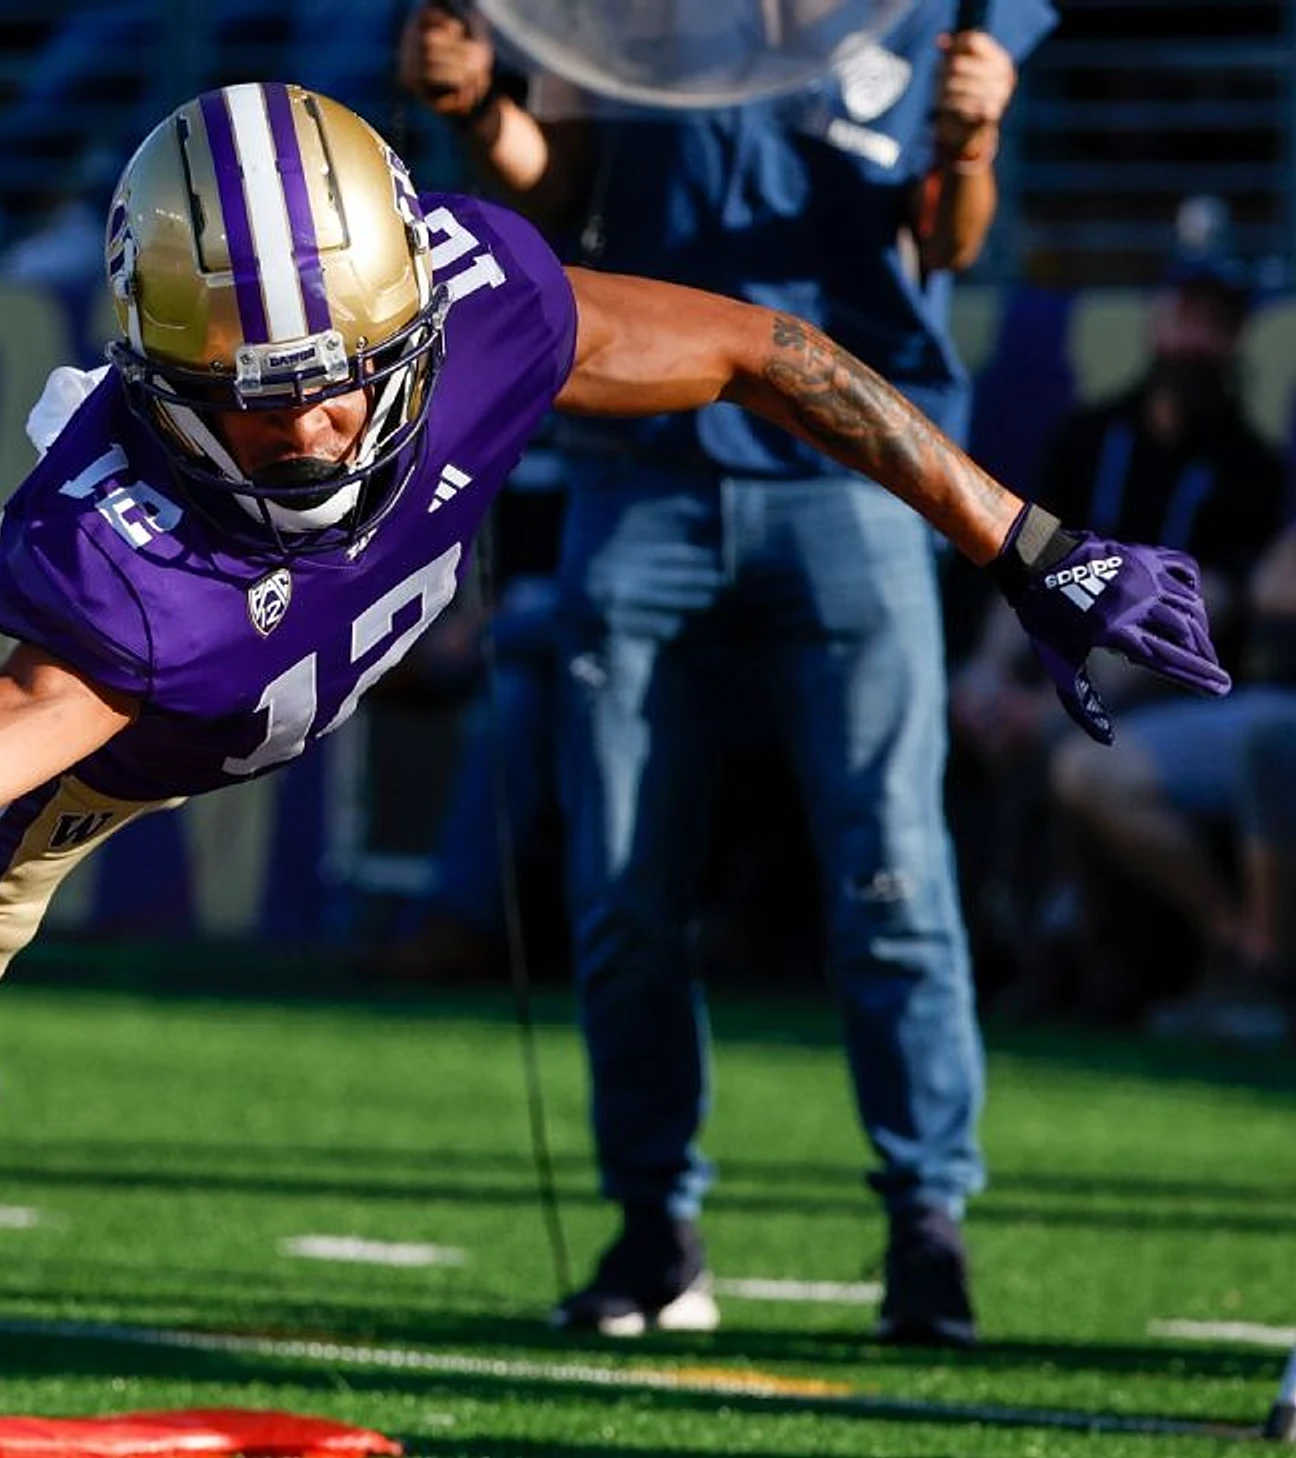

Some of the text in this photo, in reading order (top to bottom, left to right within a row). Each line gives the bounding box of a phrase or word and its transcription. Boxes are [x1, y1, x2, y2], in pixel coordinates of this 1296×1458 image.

[1045, 556, 1123, 590] adidas
[249, 573, 290, 621] PAC
[220, 541, 462, 776] 12
[49, 811, 114, 848] W
